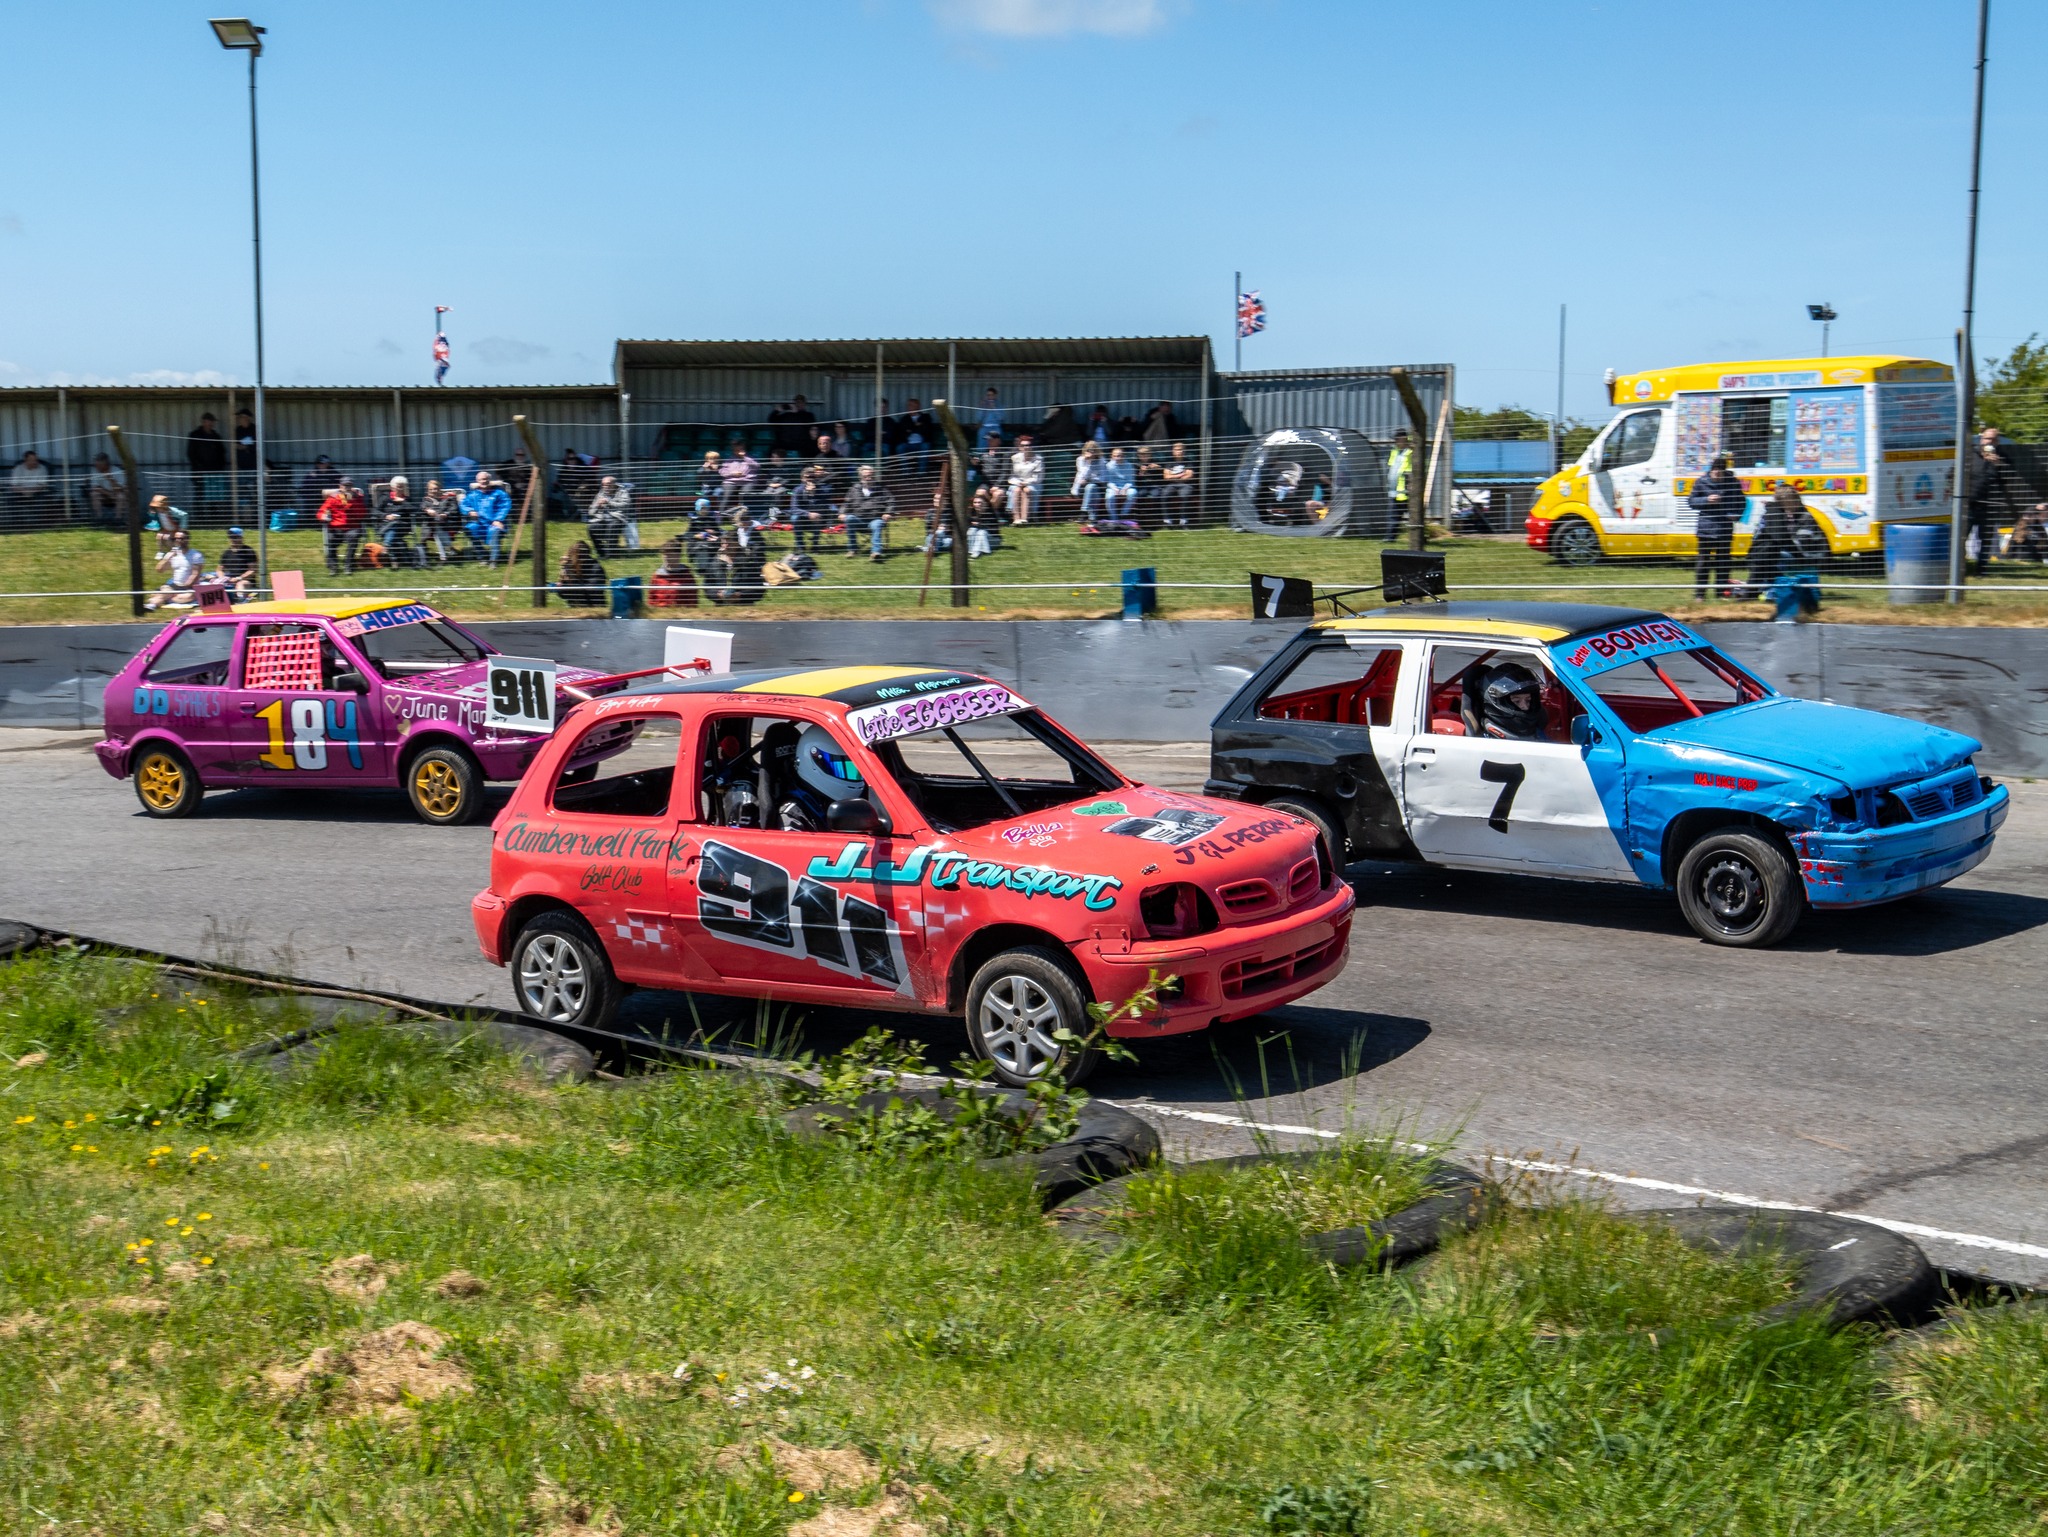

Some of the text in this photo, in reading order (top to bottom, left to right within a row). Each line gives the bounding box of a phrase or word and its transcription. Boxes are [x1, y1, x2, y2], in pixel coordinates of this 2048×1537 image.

[1793, 478, 1848, 492] CREAM
[201, 589, 226, 606] 184
[1260, 575, 1286, 619] 7
[356, 604, 435, 631] HOGAN
[1587, 620, 1691, 659] BOWEN
[401, 696, 449, 722] June
[490, 668, 550, 721] 911
[895, 687, 1022, 733] EGGBEER
[253, 698, 364, 771] 184
[1480, 760, 1526, 835] 7
[503, 822, 689, 862] Cumberwell Park
[1001, 821, 1065, 844] Bella
[580, 864, 643, 890] Golf Club
[698, 839, 906, 988] 911
